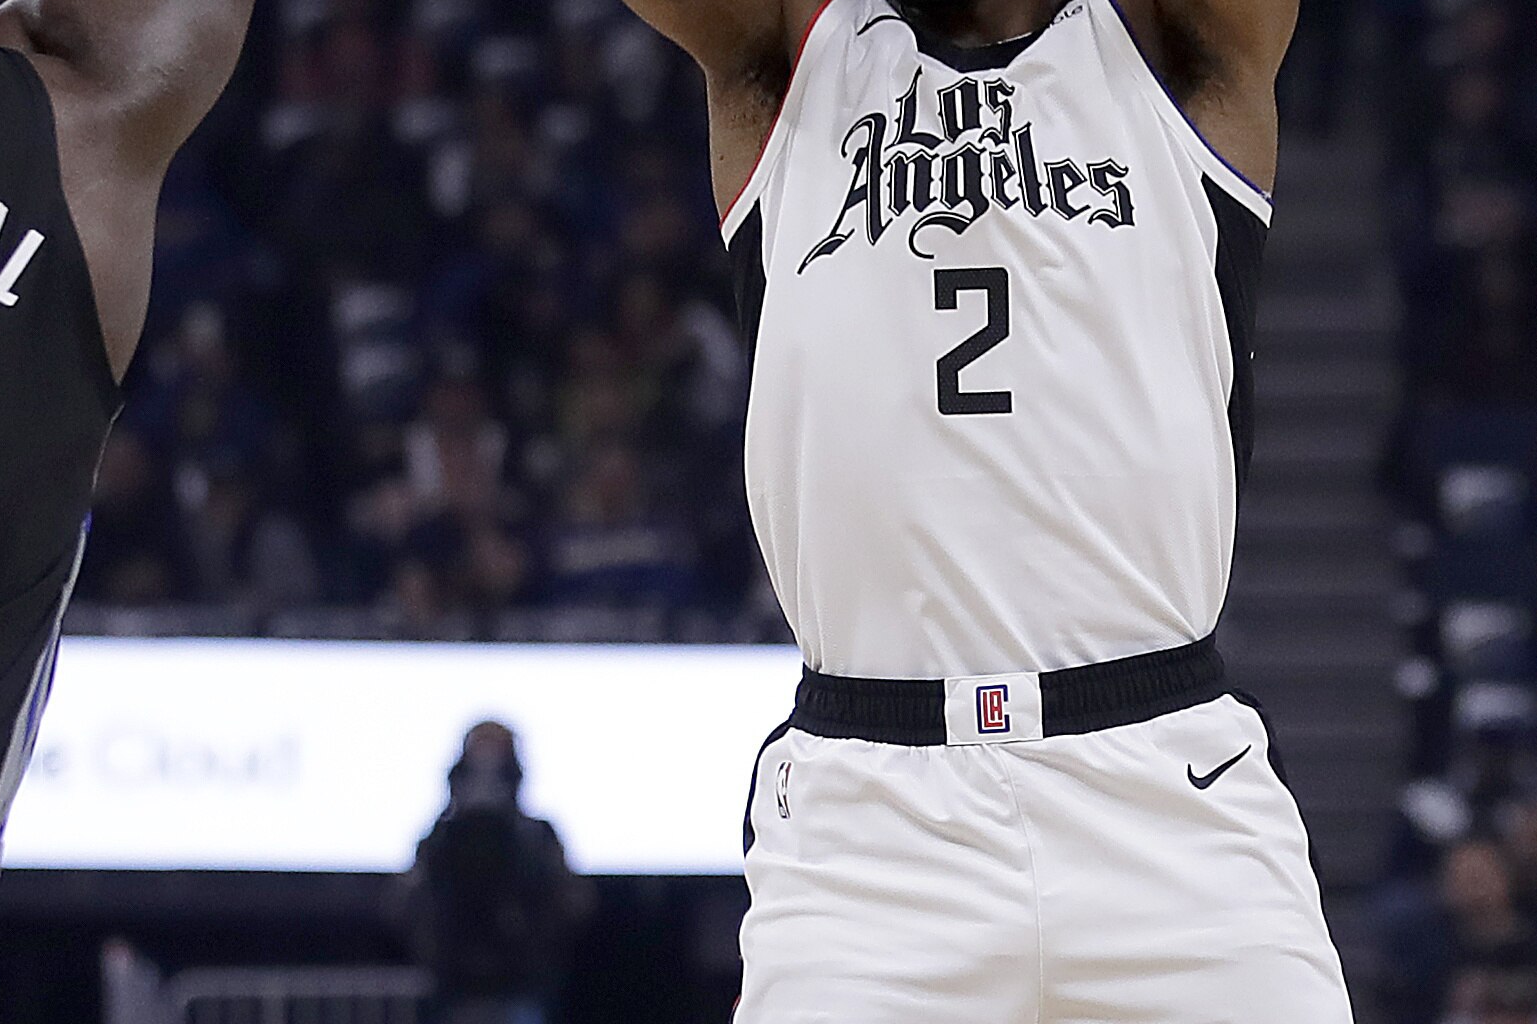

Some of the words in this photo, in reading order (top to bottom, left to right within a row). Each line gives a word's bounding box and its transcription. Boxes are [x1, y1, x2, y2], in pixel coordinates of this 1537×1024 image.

[883, 64, 1016, 152] Los
[796, 112, 1135, 276] Angeles
[934, 267, 1013, 416] 2
